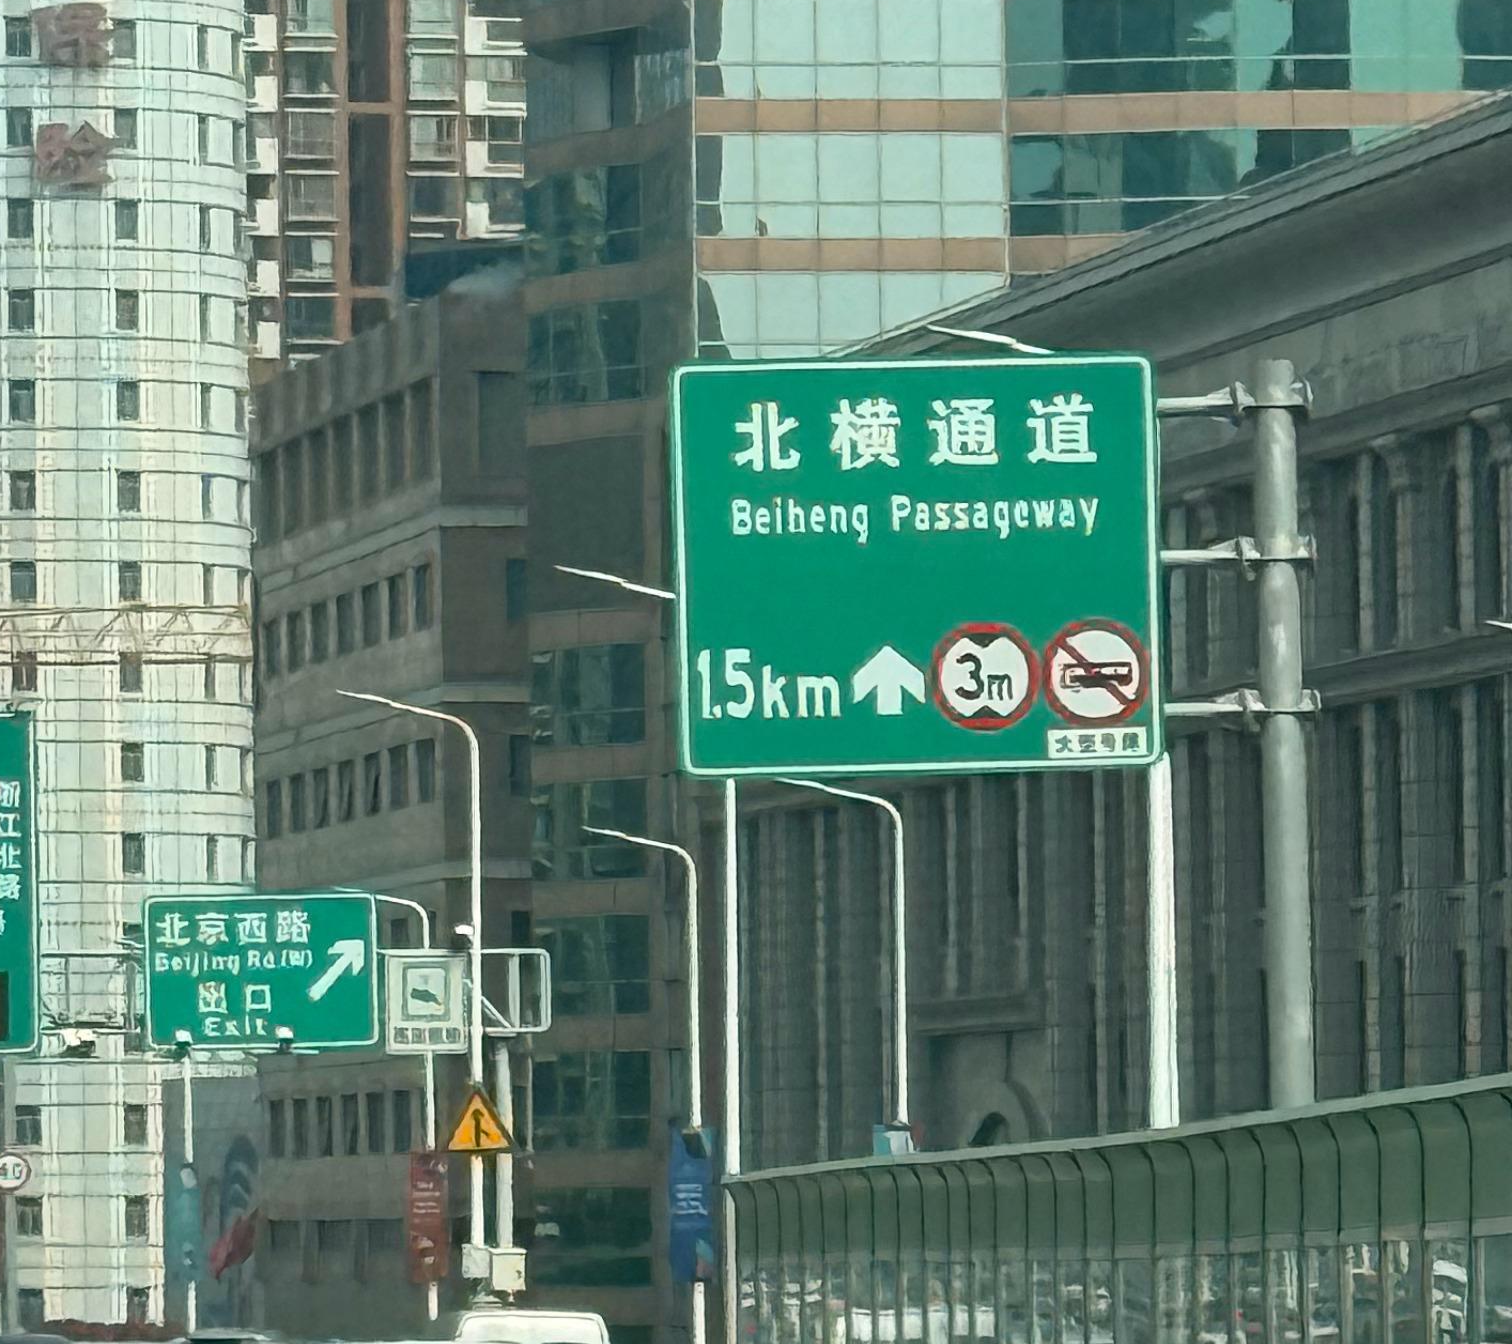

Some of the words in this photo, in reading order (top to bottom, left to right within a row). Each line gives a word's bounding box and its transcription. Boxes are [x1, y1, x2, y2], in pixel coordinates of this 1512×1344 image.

[732, 393, 1098, 471] 北横通道
[730, 497, 870, 544] Beiheng
[890, 493, 1101, 538] Passageway
[696, 648, 842, 720] 1.5km
[955, 652, 1014, 702] 3m
[155, 910, 311, 947] 北京西路
[155, 950, 240, 977] Beijing
[198, 981, 272, 1014] 出口
[203, 1013, 269, 1036] Exit
